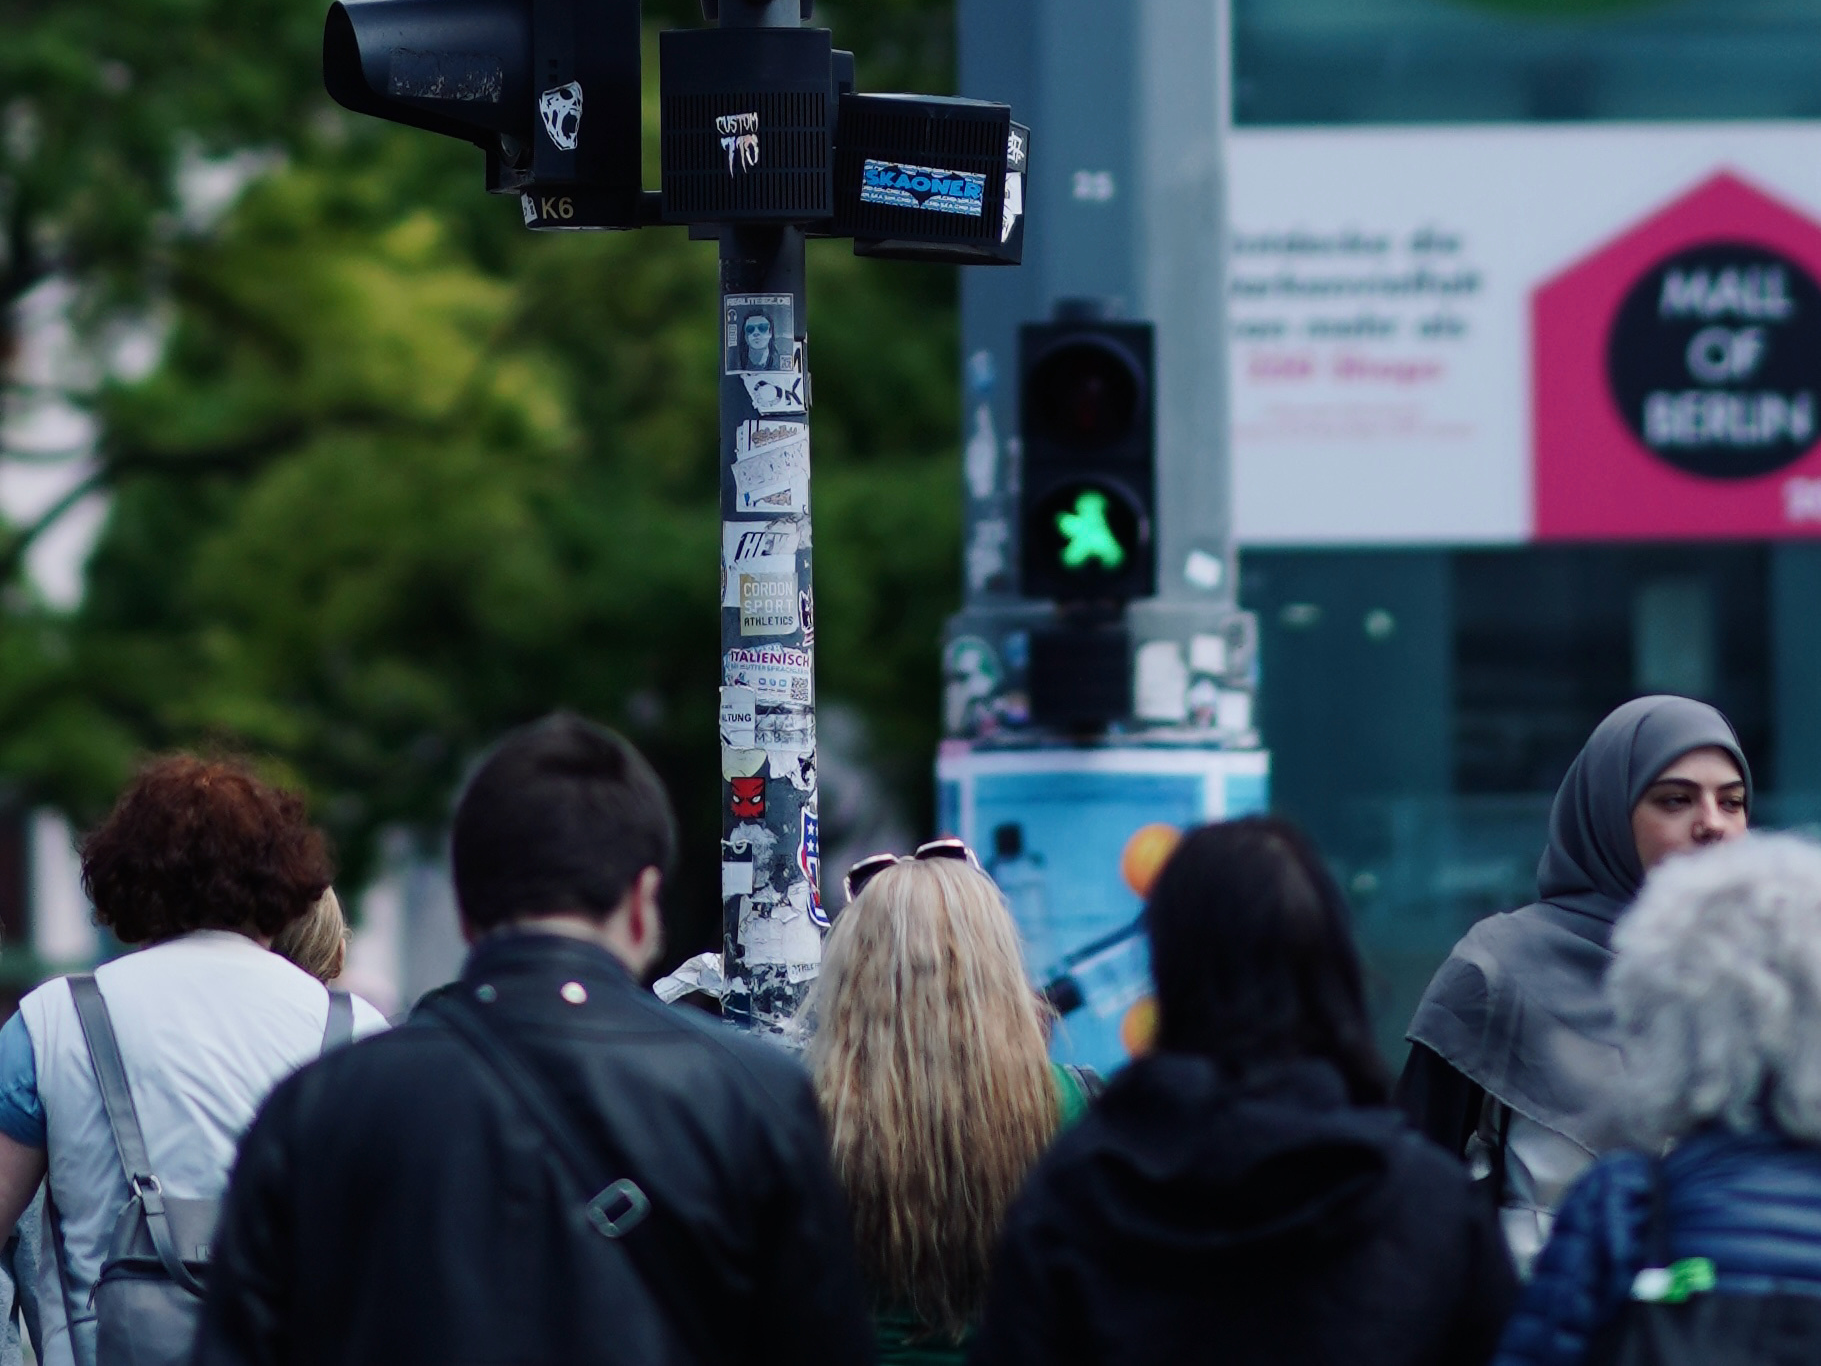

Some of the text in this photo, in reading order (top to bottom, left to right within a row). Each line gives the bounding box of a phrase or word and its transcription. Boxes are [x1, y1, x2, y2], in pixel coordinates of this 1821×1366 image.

[716, 112, 758, 134] CUSTOM
[865, 168, 982, 199] SKAONER
[541, 196, 574, 219] K6
[1659, 266, 1795, 319] MALL
[1684, 325, 1767, 383] OF
[744, 581, 793, 597] CORDON
[744, 599, 794, 614] SPORT
[744, 616, 794, 627] ATHLETICS
[731, 651, 810, 667] ITALIENISCH
[722, 713, 751, 722] LTUNG
